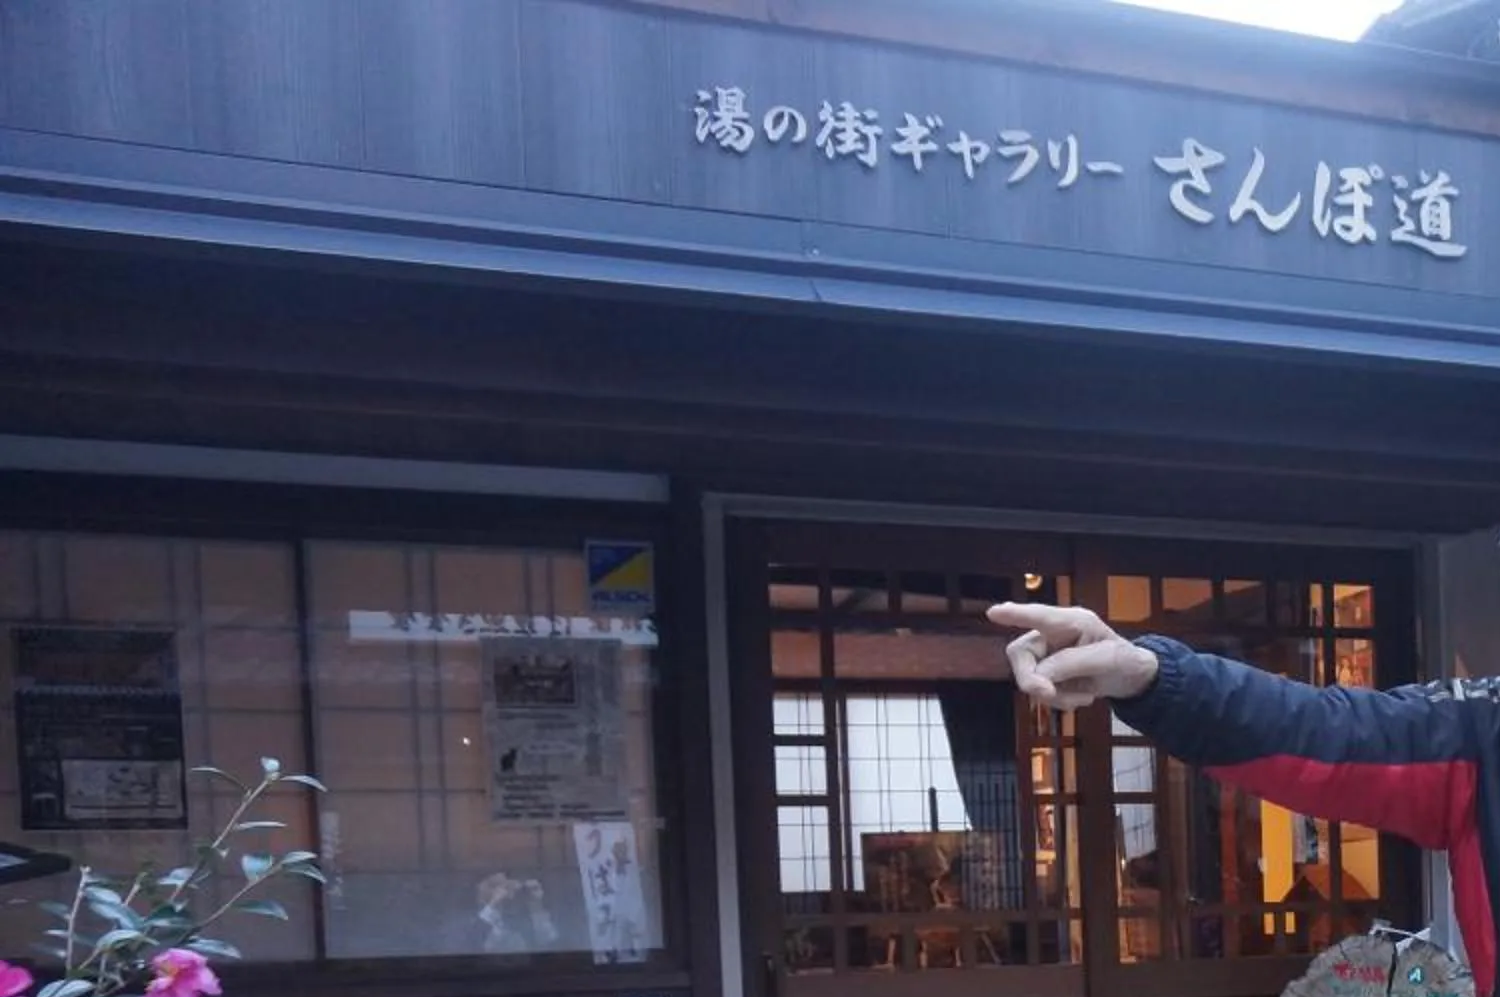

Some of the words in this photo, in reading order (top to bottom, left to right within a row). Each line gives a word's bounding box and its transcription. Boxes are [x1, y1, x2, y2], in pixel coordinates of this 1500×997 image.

[694, 87, 1124, 189] 湯の街ギャラリー
[1153, 136, 1467, 257] さんぽ道
